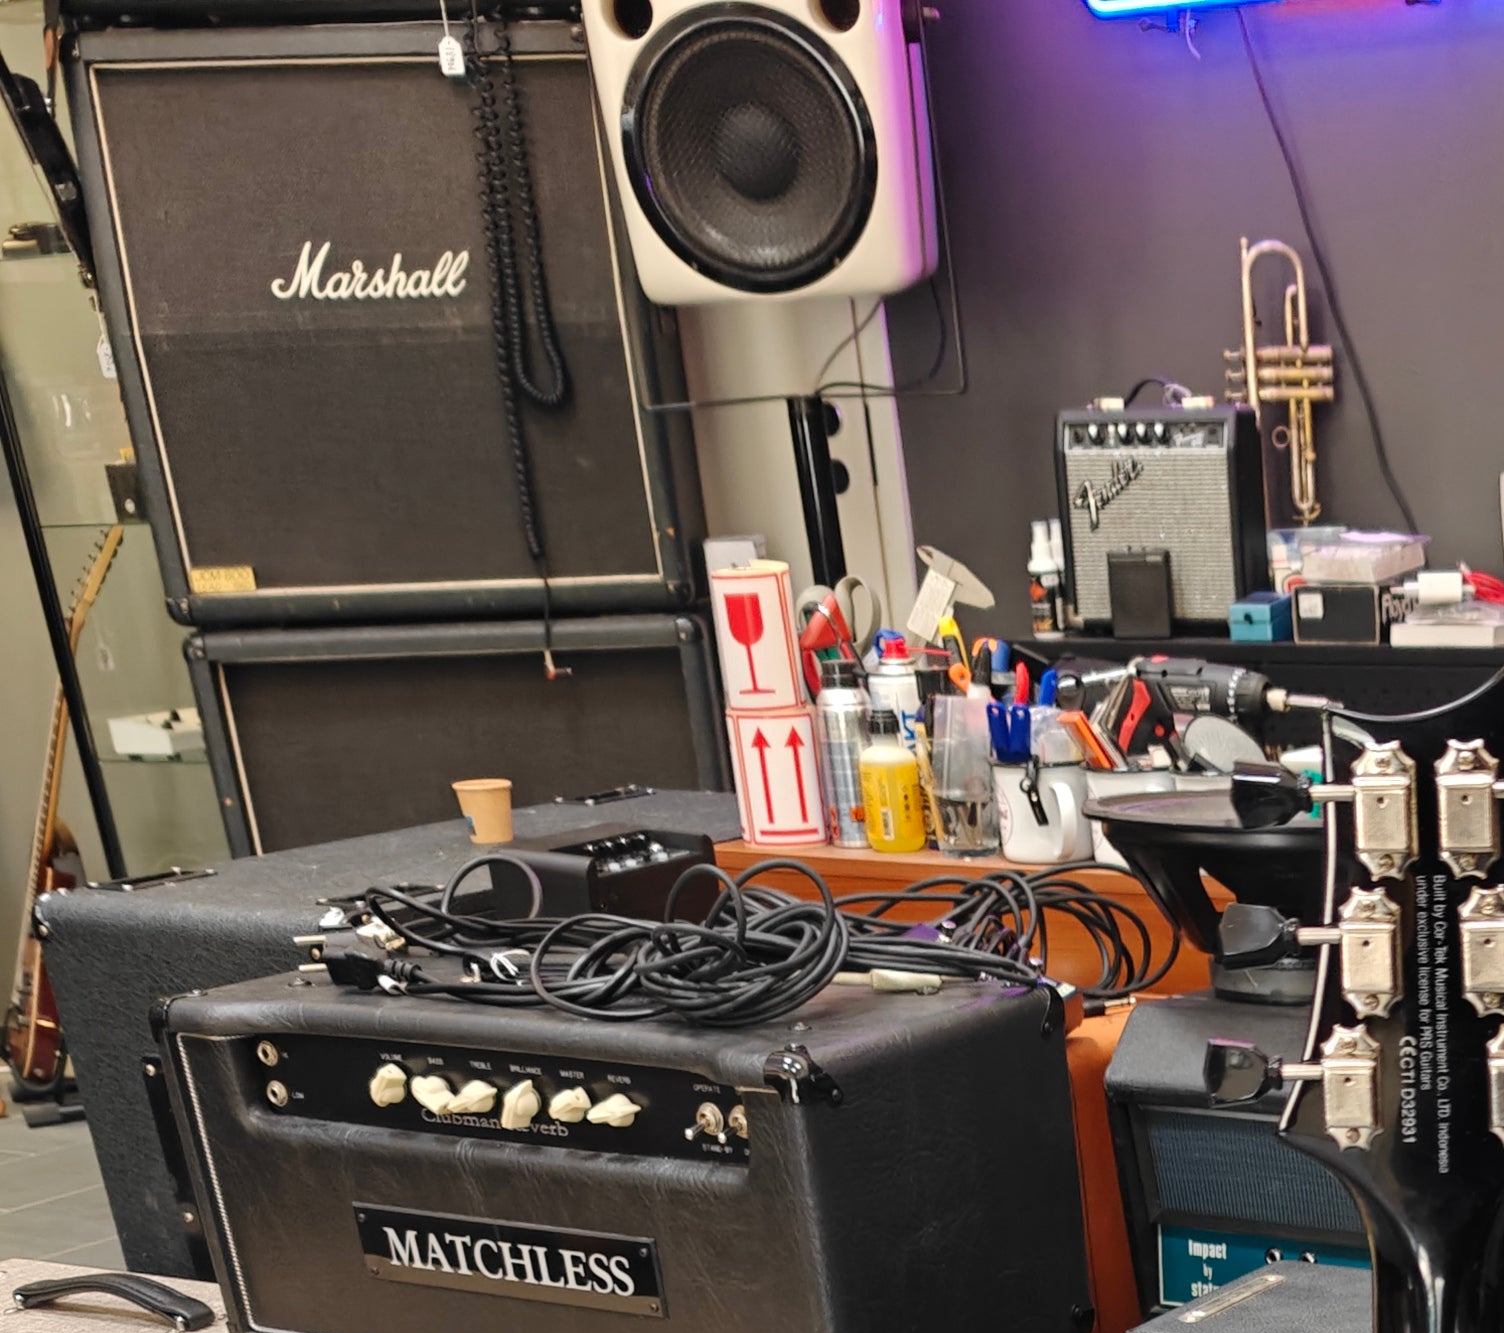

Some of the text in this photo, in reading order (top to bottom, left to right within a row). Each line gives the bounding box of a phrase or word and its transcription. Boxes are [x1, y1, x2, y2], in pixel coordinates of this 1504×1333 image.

[271, 240, 469, 299] Marshall
[1433, 875, 1447, 901] Built
[1431, 904, 1447, 918] by
[1416, 875, 1434, 1091] under exclusive license for PRS Guitars
[1434, 967, 1449, 1011] Musical
[380, 1053, 403, 1062] VOLUME
[1435, 1013, 1450, 1073] Instrument
[559, 1069, 585, 1080] MASTER
[1437, 1122, 1450, 1174] Indonesia
[382, 1226, 635, 1297] MATCHLESS
[1188, 1239, 1227, 1261] Impact
[1203, 1263, 1213, 1281] by
